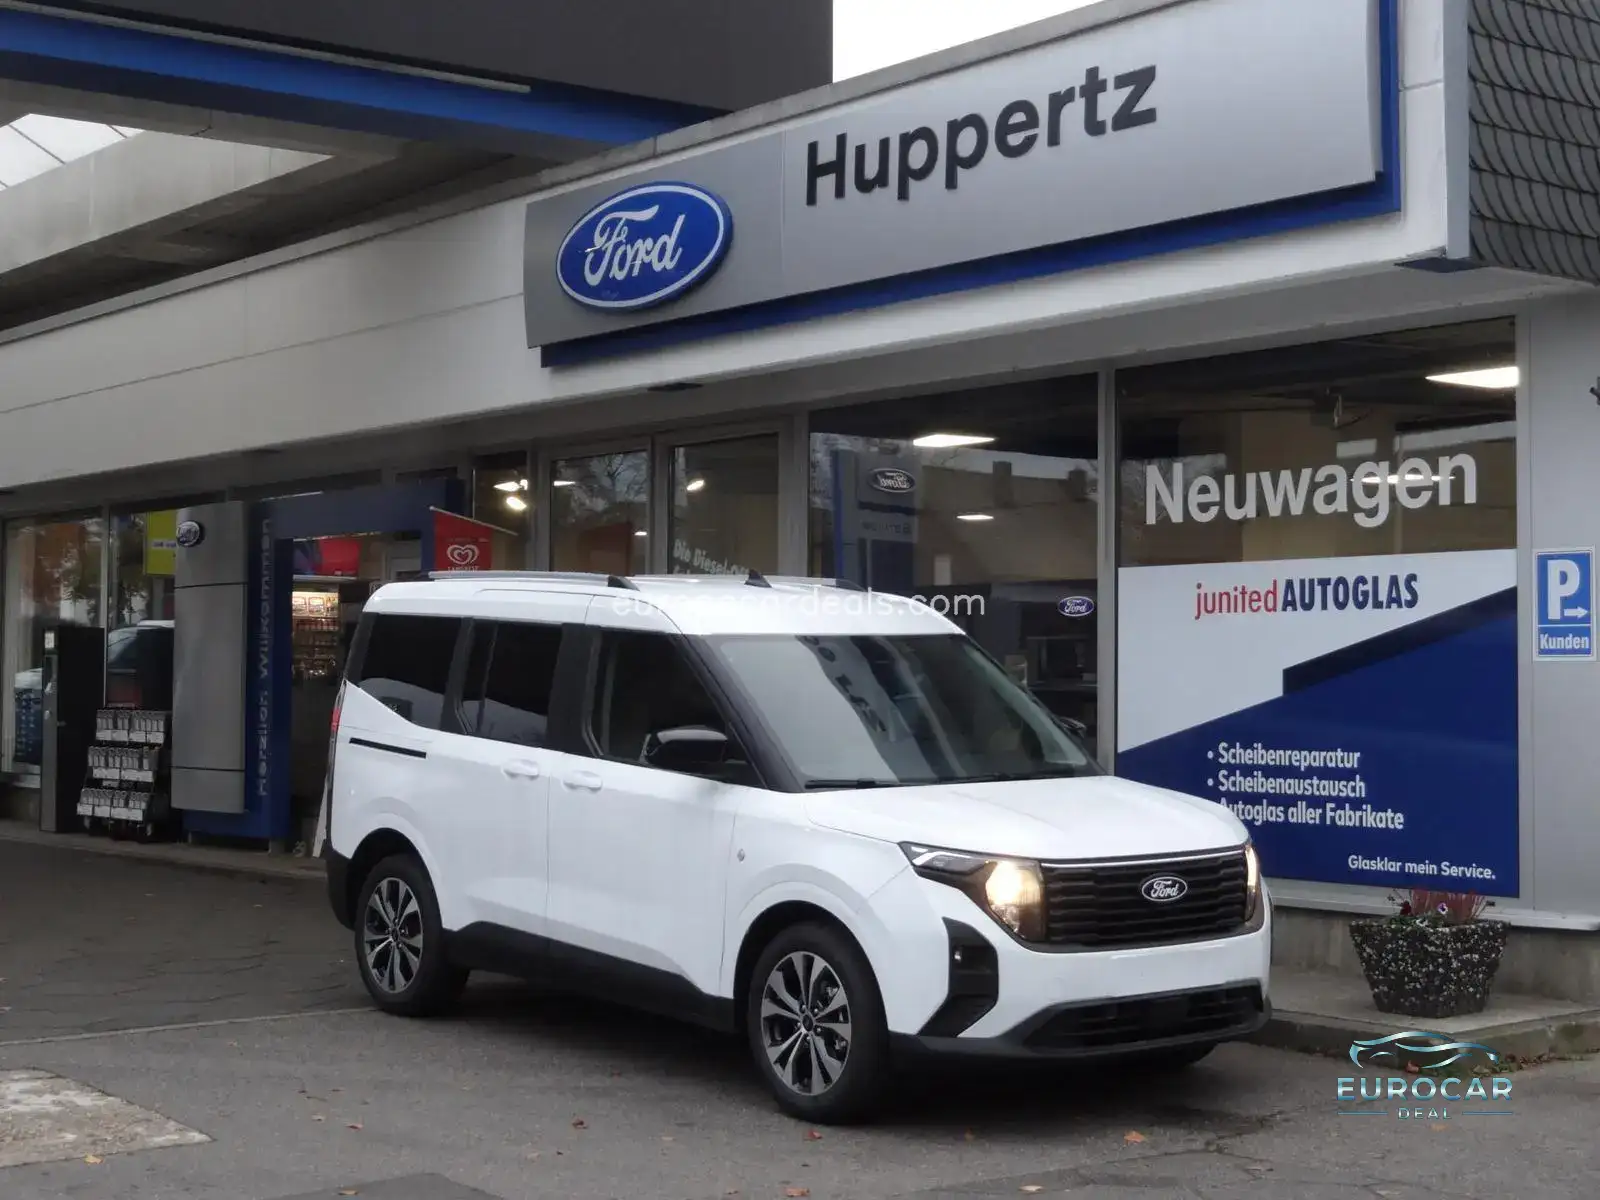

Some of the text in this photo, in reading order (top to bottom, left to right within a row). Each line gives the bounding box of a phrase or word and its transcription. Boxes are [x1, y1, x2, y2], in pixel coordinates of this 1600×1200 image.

[805, 64, 1158, 206] Huppertz
[582, 204, 686, 287] Ford
[1145, 453, 1478, 528] Neuwagen
[1194, 573, 1419, 620] junited AUTOGLAS
[1548, 559, 1581, 620] P
[1539, 633, 1590, 651] Kunden
[1218, 742, 1361, 771] Scheibenreparatur
[1218, 770, 1366, 798] Scheibenaustausch
[1288, 801, 1323, 824] aller
[1325, 804, 1405, 830] Fabrikate
[1348, 854, 1496, 881] Glasklar mein Service.
[1150, 879, 1182, 899] Ford
